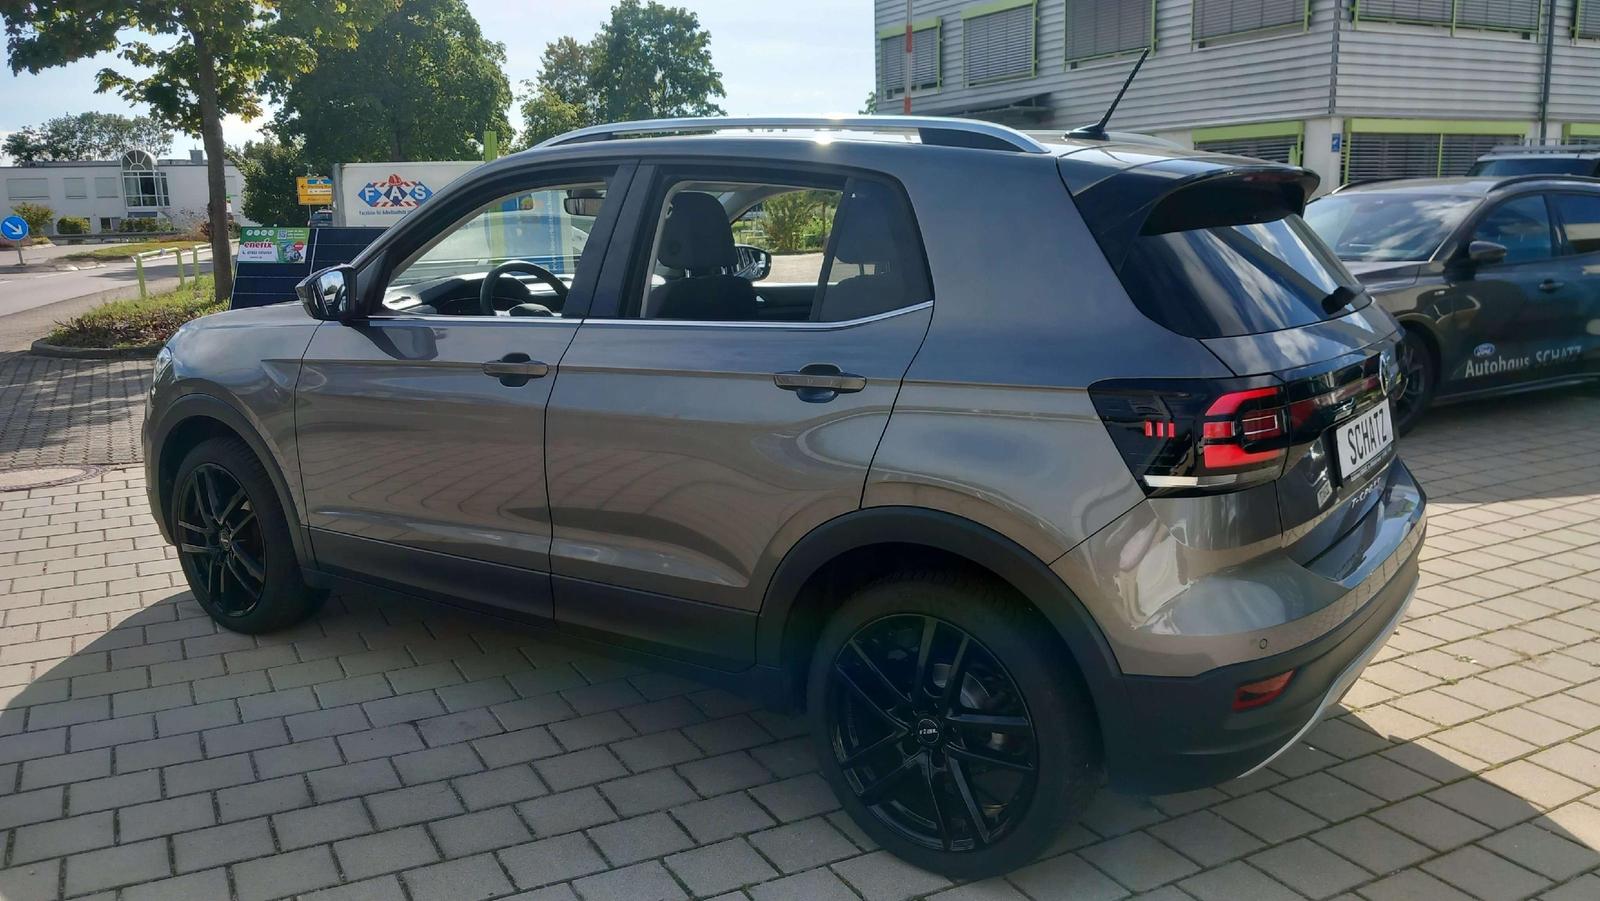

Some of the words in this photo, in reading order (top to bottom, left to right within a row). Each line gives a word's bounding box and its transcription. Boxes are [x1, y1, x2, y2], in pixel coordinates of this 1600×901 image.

[364, 185, 427, 202] FAS
[1465, 355, 1529, 378] Autohaus
[1347, 408, 1387, 465] SCHATZ
